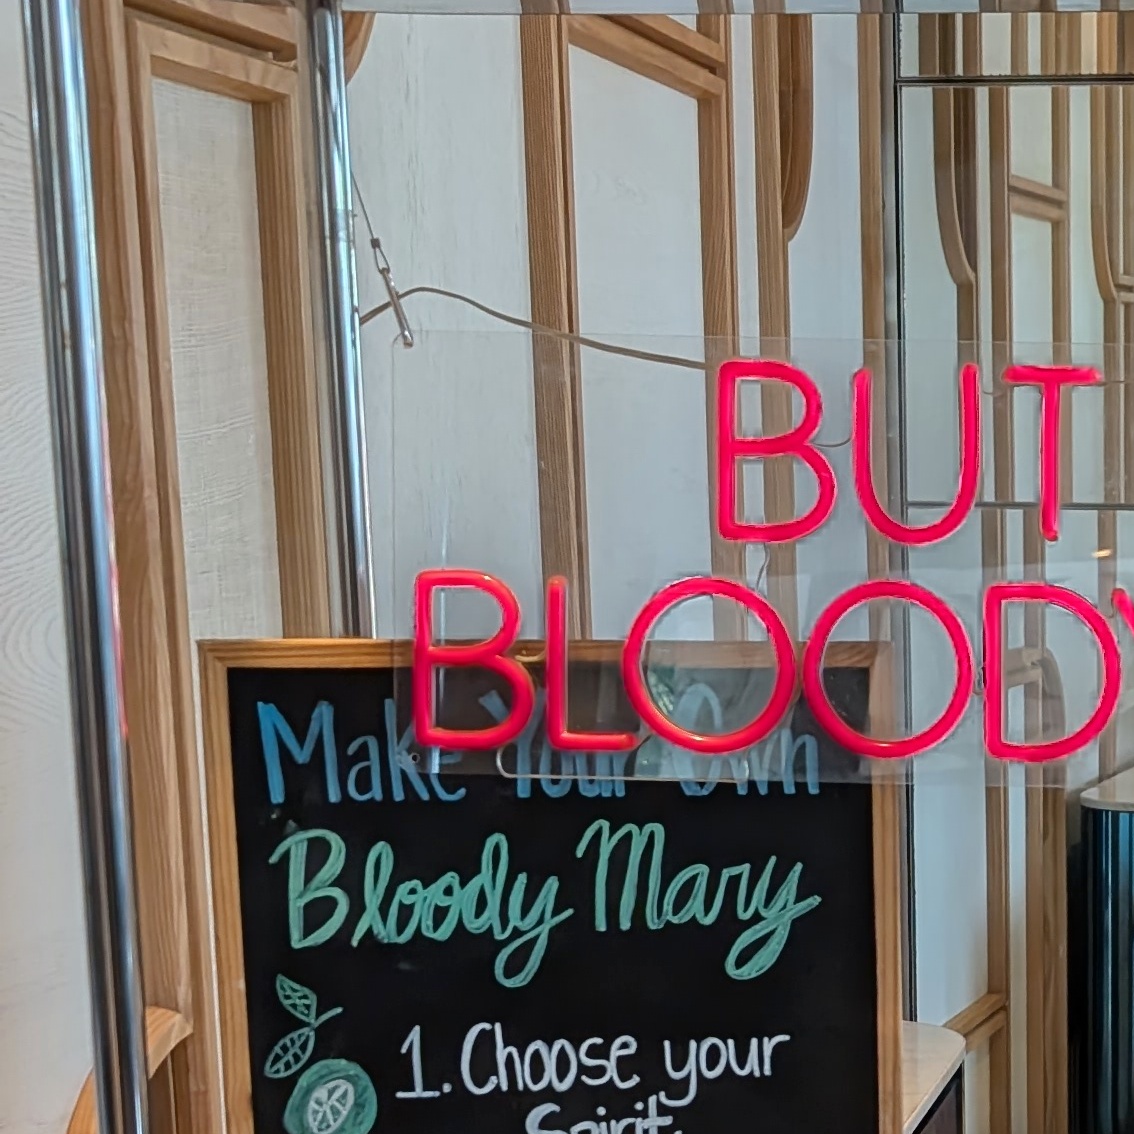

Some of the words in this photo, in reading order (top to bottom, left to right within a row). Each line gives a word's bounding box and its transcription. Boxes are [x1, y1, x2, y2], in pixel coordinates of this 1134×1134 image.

[716, 358, 1102, 545] BUT
[257, 698, 467, 803] Make
[479, 689, 628, 798] Your
[672, 683, 820, 797] Own
[269, 828, 574, 987] Bloody
[576, 819, 822, 981] Mary
[663, 1031, 791, 1107] your
